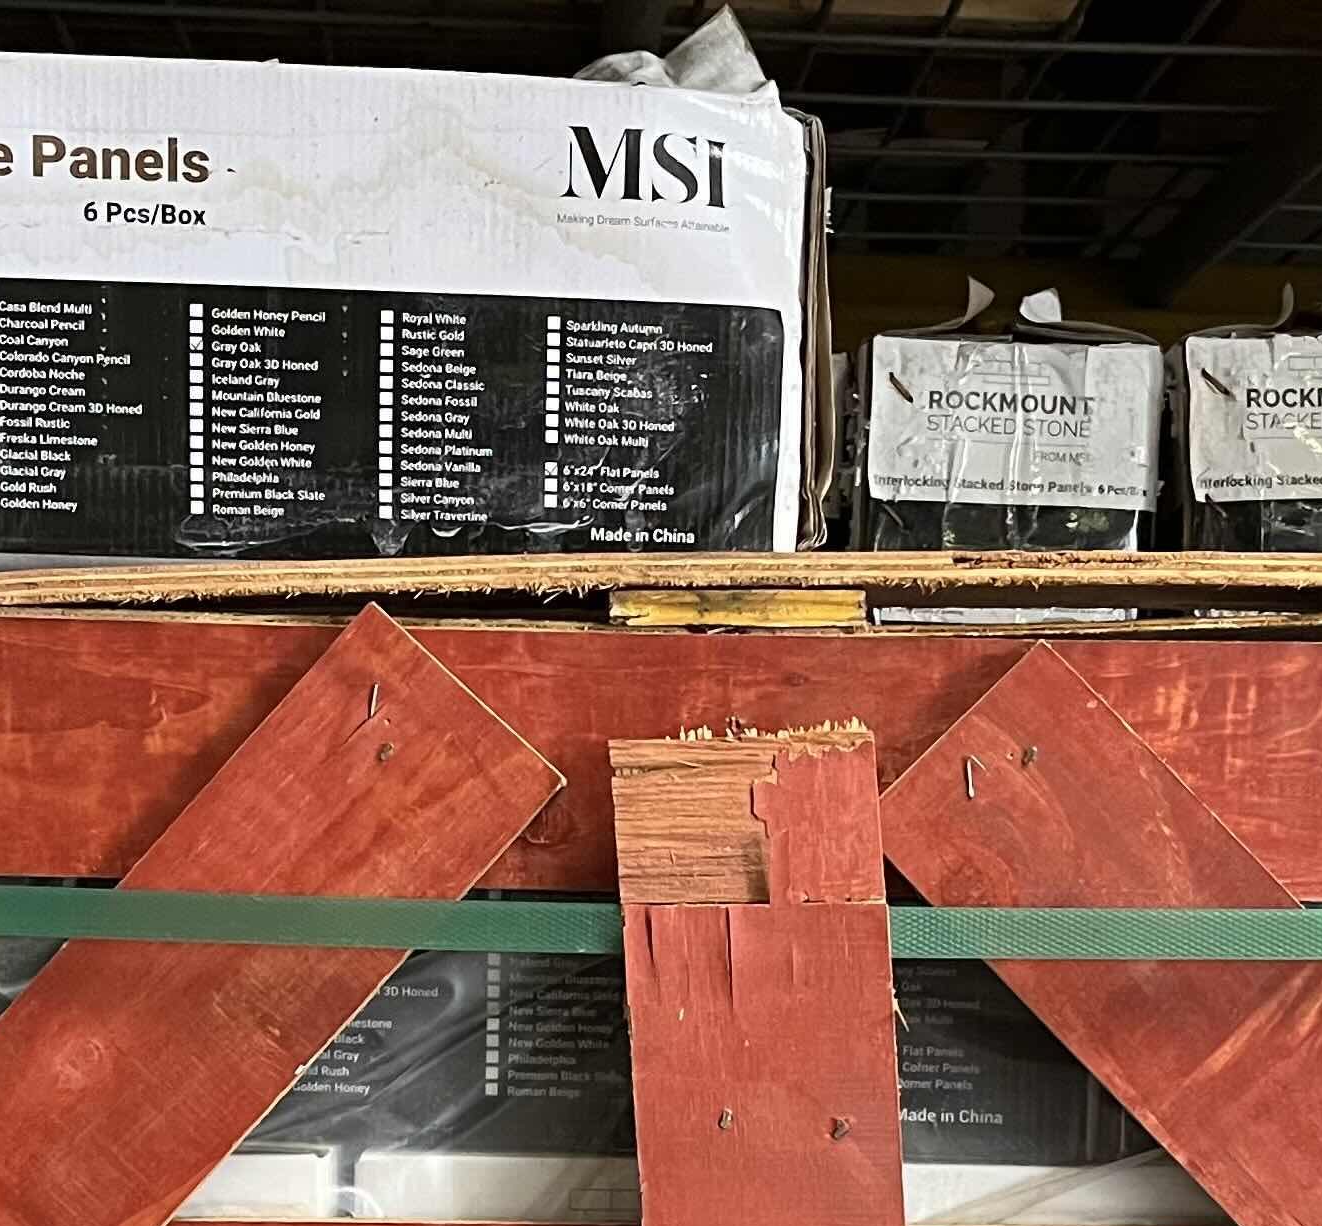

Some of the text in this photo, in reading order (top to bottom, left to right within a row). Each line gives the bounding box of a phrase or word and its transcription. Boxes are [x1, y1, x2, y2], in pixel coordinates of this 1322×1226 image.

[31, 136, 211, 184] Panels
[560, 126, 725, 208] MSI
[83, 201, 207, 228] 6 Pcs/Box
[557, 214, 594, 226] Making
[597, 215, 630, 225] Dream
[29, 302, 60, 313] Blend
[64, 303, 92, 314] Multi
[212, 308, 326, 323] Golden Honey Pencil
[402, 312, 466, 326] Royal White
[0, 318, 85, 331] Charcoal Pencil
[566, 320, 662, 335] Sparkling Autumn
[0, 335, 68, 347] Coal Canyon
[402, 329, 464, 341] Rustic Gold
[212, 341, 261, 354] Gray Oak
[0, 351, 130, 365] Colorado Canyon Pencil
[566, 353, 637, 365] Sunset Silver
[0, 368, 85, 380] Cordoba Noche
[401, 362, 476, 376] Sedona Beige
[401, 378, 485, 391] Sedona Classic
[0, 400, 142, 415] Durango Cream 3D Honed
[929, 390, 1095, 416] ROCKMOUNT
[212, 407, 320, 420] New California Gold
[0, 416, 70, 429] Fossil Rustic
[927, 414, 1091, 438] STACKED STONE
[0, 433, 98, 446] Freska Limestone
[401, 461, 481, 473] Sedona Vanilla
[601, 466, 659, 479] Flat Panels
[1200, 473, 1273, 488] nterlocking
[212, 488, 325, 501] Premium Black Slate
[401, 494, 474, 507] Silver Canyon
[0, 498, 77, 512] Golden Honey
[212, 504, 284, 518] Roman Beige
[591, 528, 694, 544] Made in China
[384, 986, 439, 998] 3D Honed
[321, 1066, 349, 1077] Rush
[335, 1083, 371, 1096] Honey
[897, 1108, 1003, 1125] Made in China
